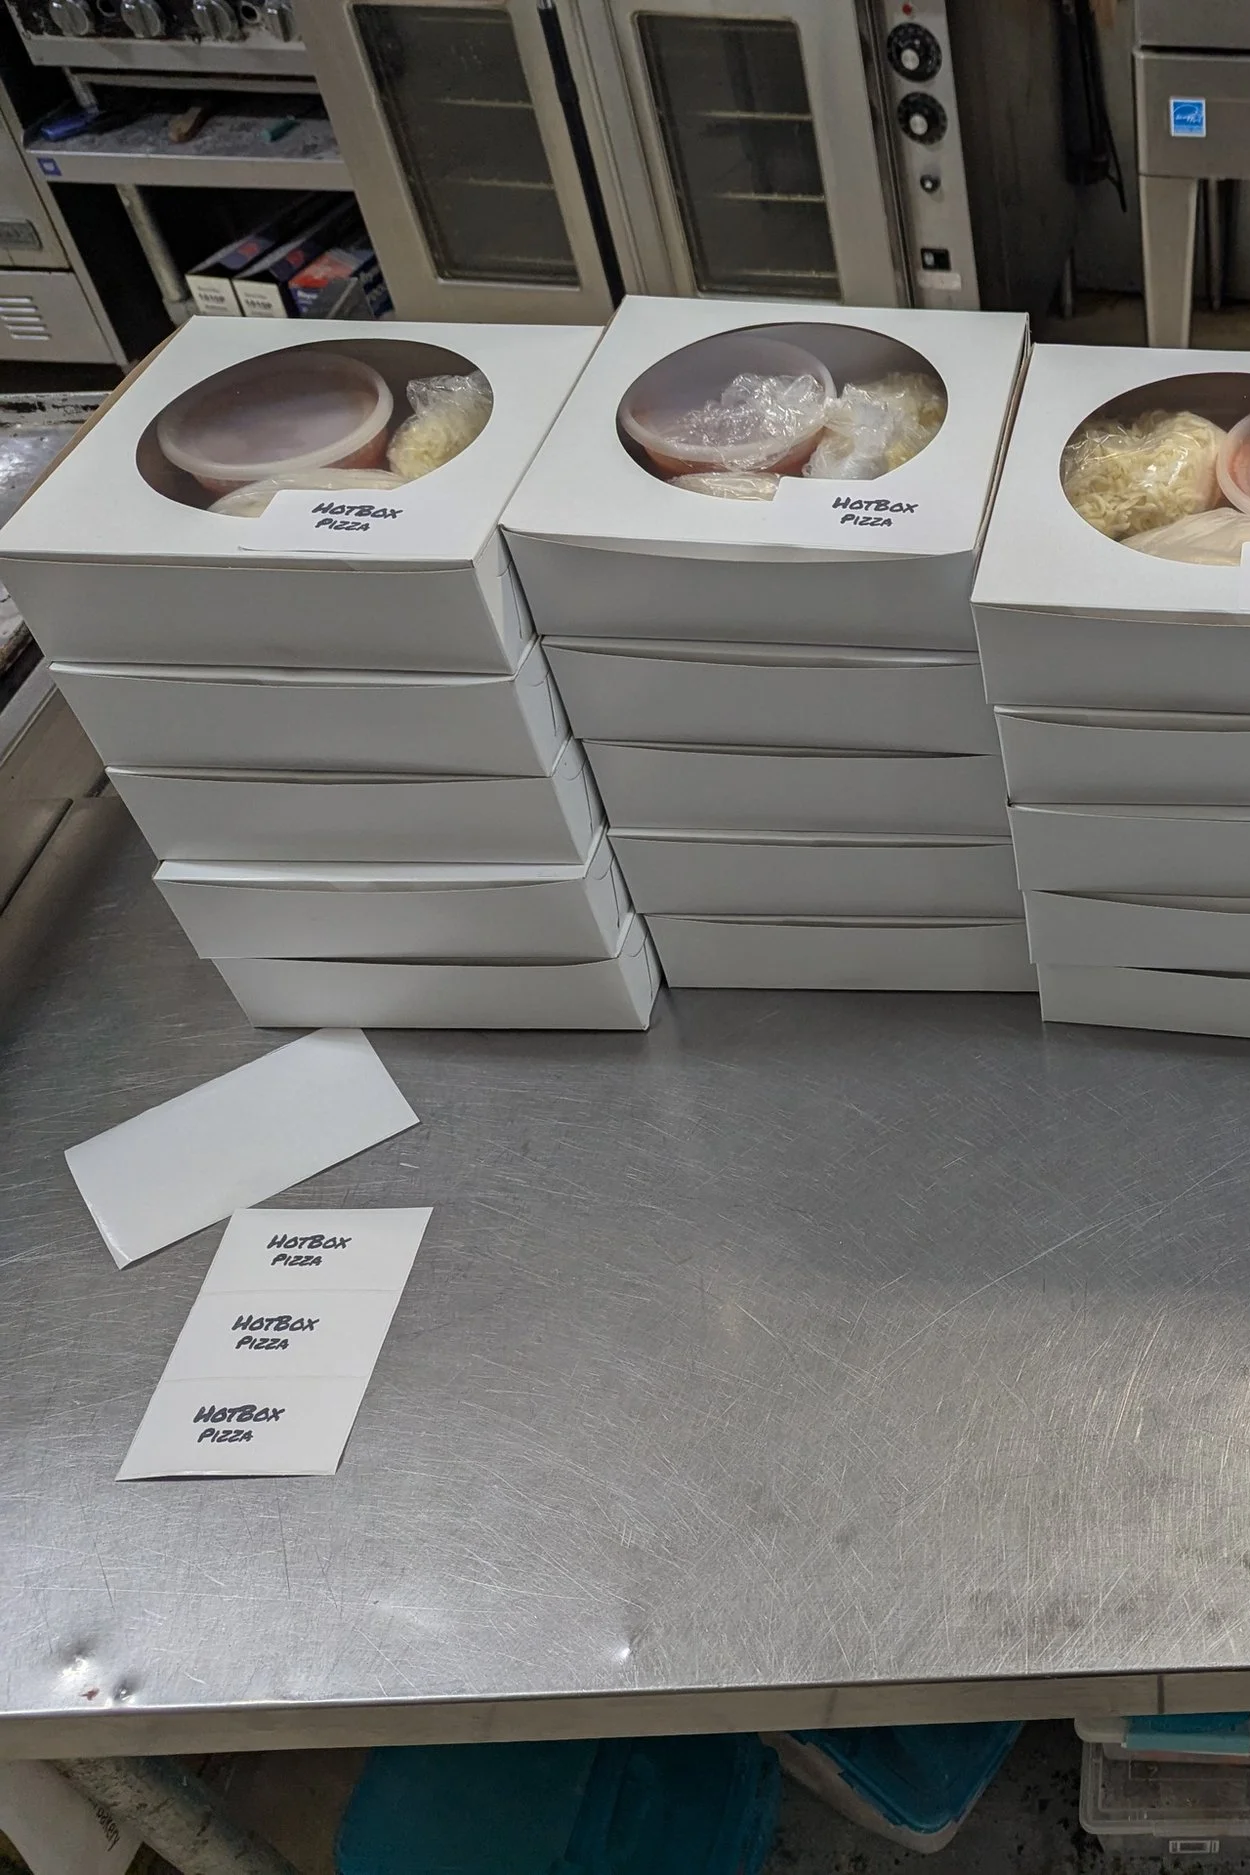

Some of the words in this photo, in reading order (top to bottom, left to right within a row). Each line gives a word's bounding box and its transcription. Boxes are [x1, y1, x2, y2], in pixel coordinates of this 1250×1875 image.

[314, 517, 371, 532] PIZZA
[839, 513, 893, 528] PIZZA
[270, 1253, 323, 1267] PIZZA
[234, 1335, 290, 1351] PIZZA
[196, 1427, 254, 1444] PIZZA
